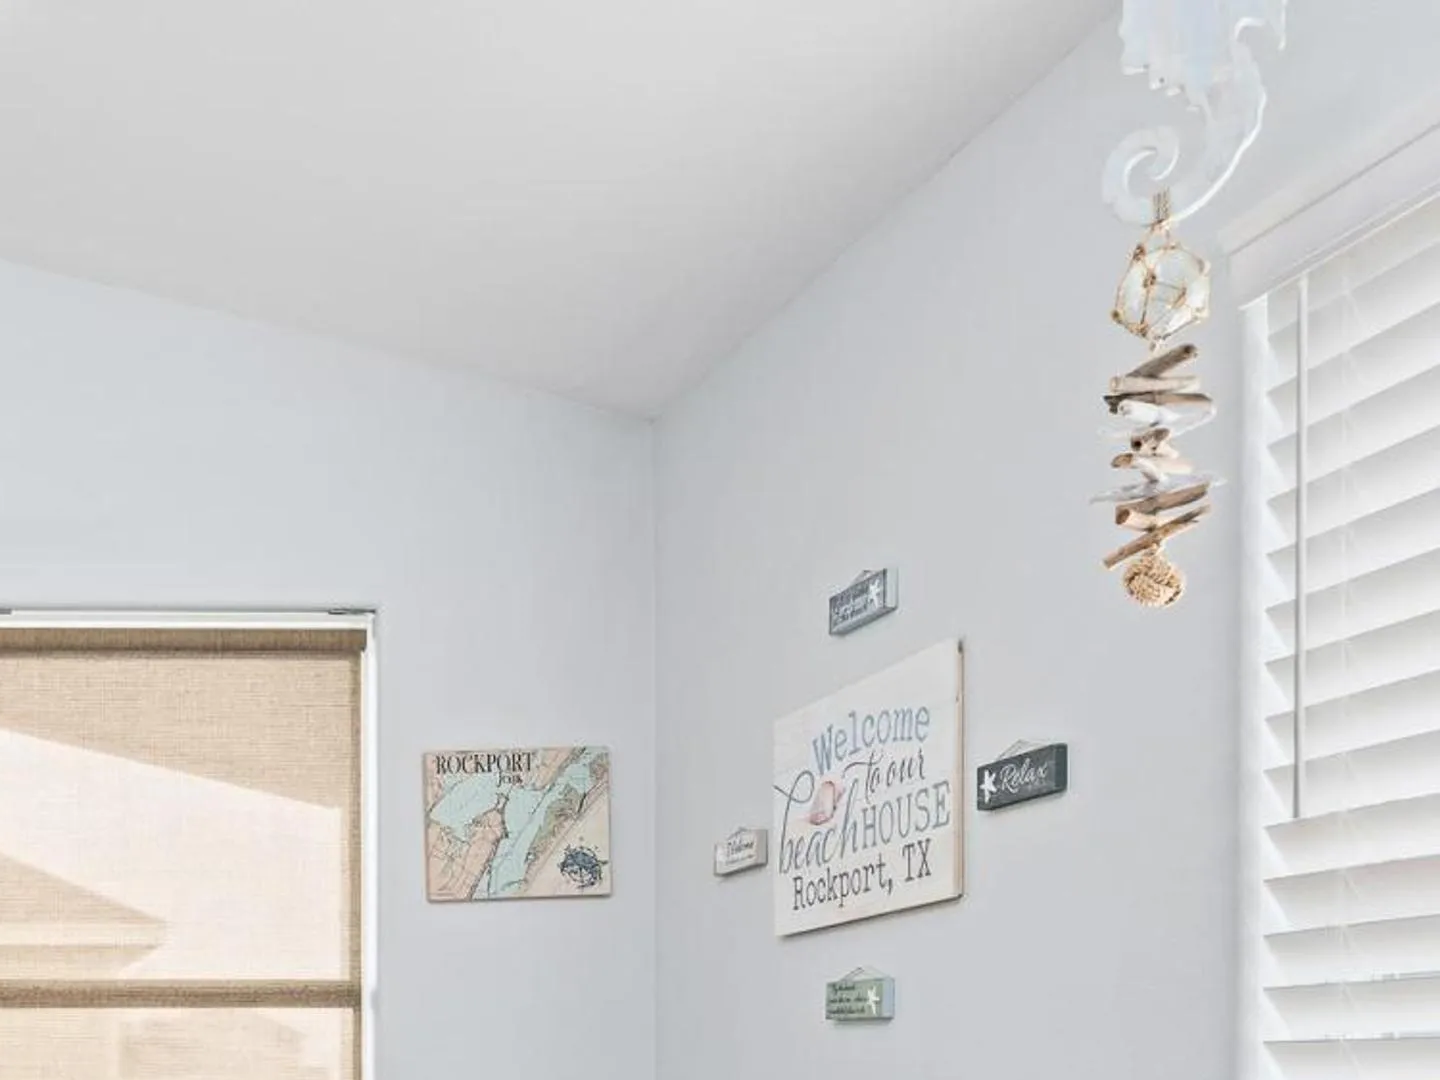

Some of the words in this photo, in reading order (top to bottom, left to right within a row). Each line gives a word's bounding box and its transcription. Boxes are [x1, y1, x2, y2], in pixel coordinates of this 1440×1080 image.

[435, 751, 534, 775] ROCKPORT
[812, 705, 931, 775] Welcome
[844, 749, 883, 804] to
[886, 748, 927, 786] our
[792, 856, 895, 911] Rockport,
[902, 838, 933, 883] TX
